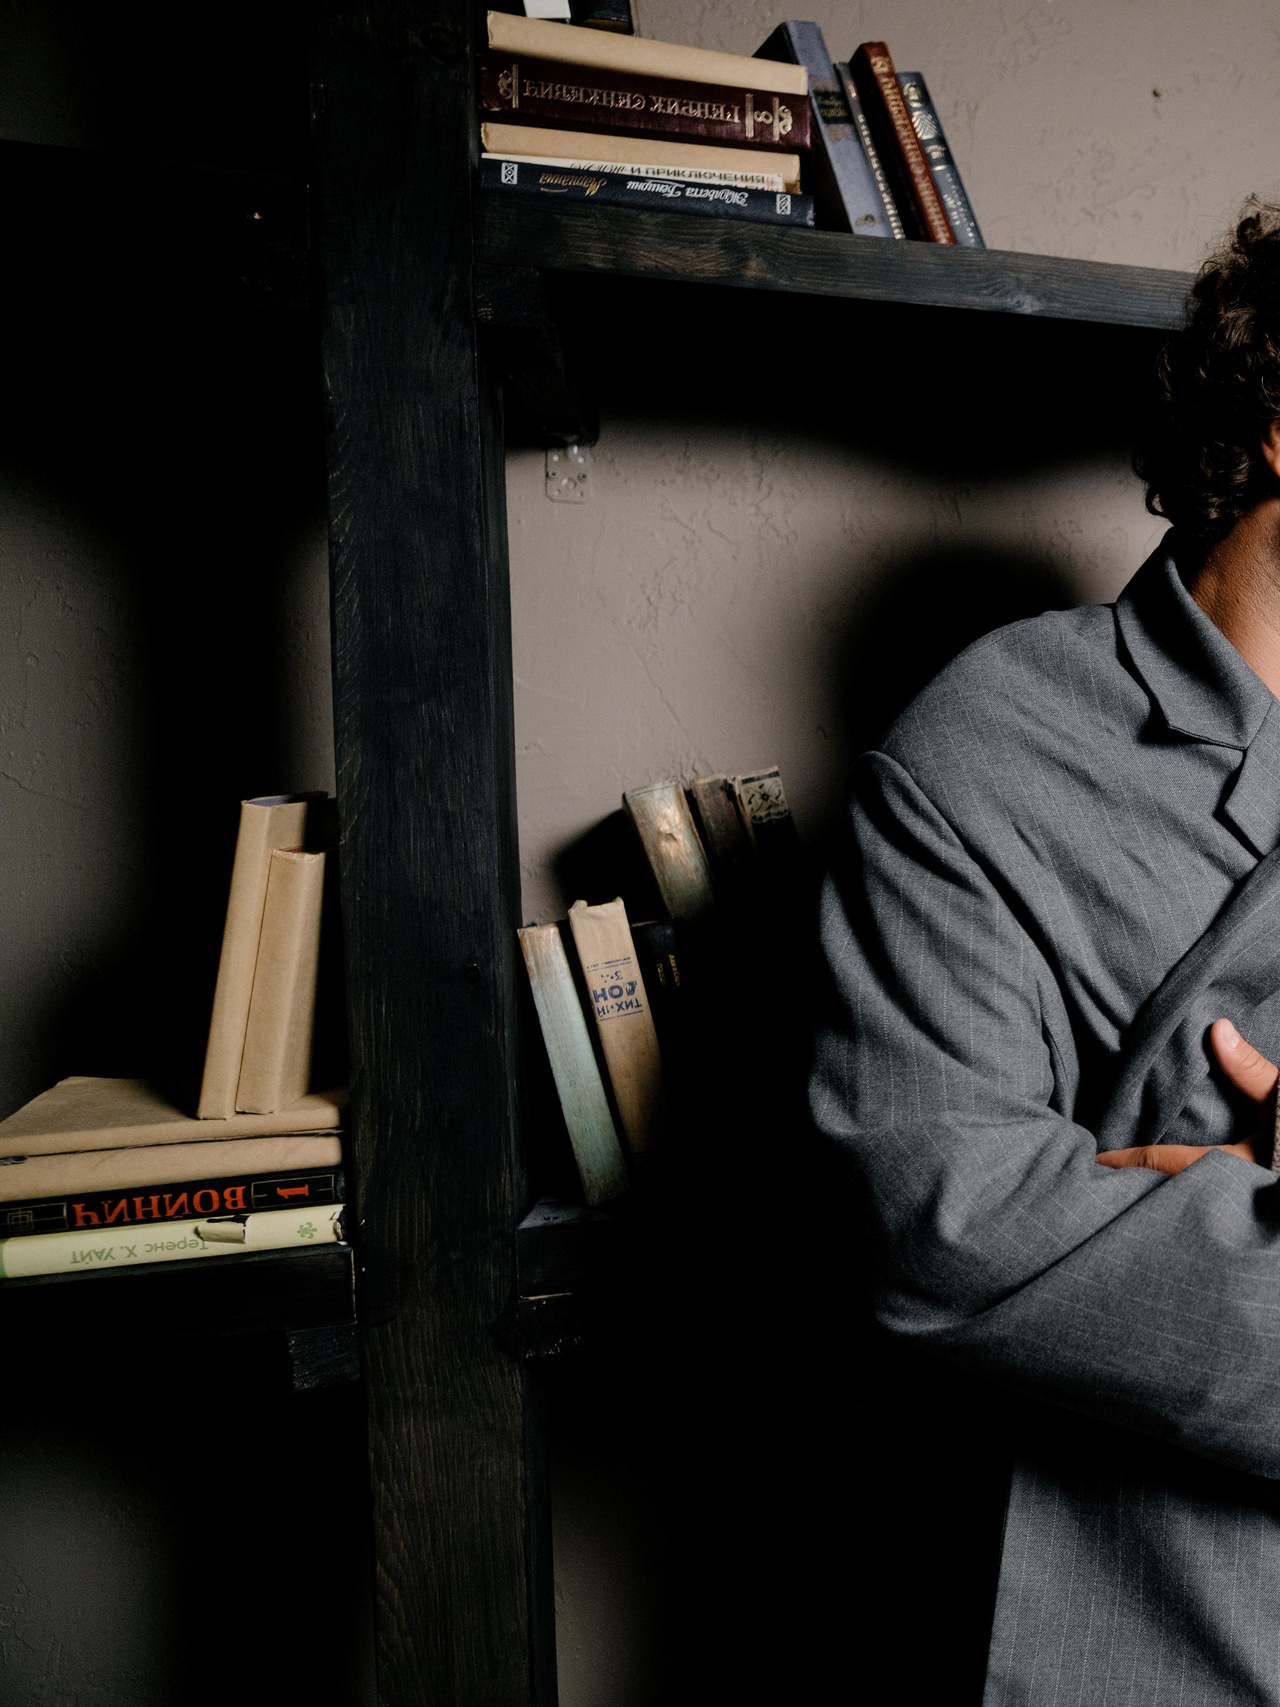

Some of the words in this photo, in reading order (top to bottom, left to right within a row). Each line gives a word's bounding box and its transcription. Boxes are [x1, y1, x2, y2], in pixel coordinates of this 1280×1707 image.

[523, 77, 646, 109] СЕНКЕВИЧ
[649, 94, 742, 124] ГЕНРИК
[538, 172, 608, 198] Марианна
[646, 167, 765, 184] ПРИКЛЮЧЕНИЯ
[626, 179, 685, 199] Бенцони
[685, 186, 749, 207] Жюльетта
[592, 980, 638, 1003] ДОН
[72, 1185, 248, 1227] ВОЙНИЧ
[70, 1248, 115, 1265] УАЙТ
[145, 1237, 211, 1254] Теренс
